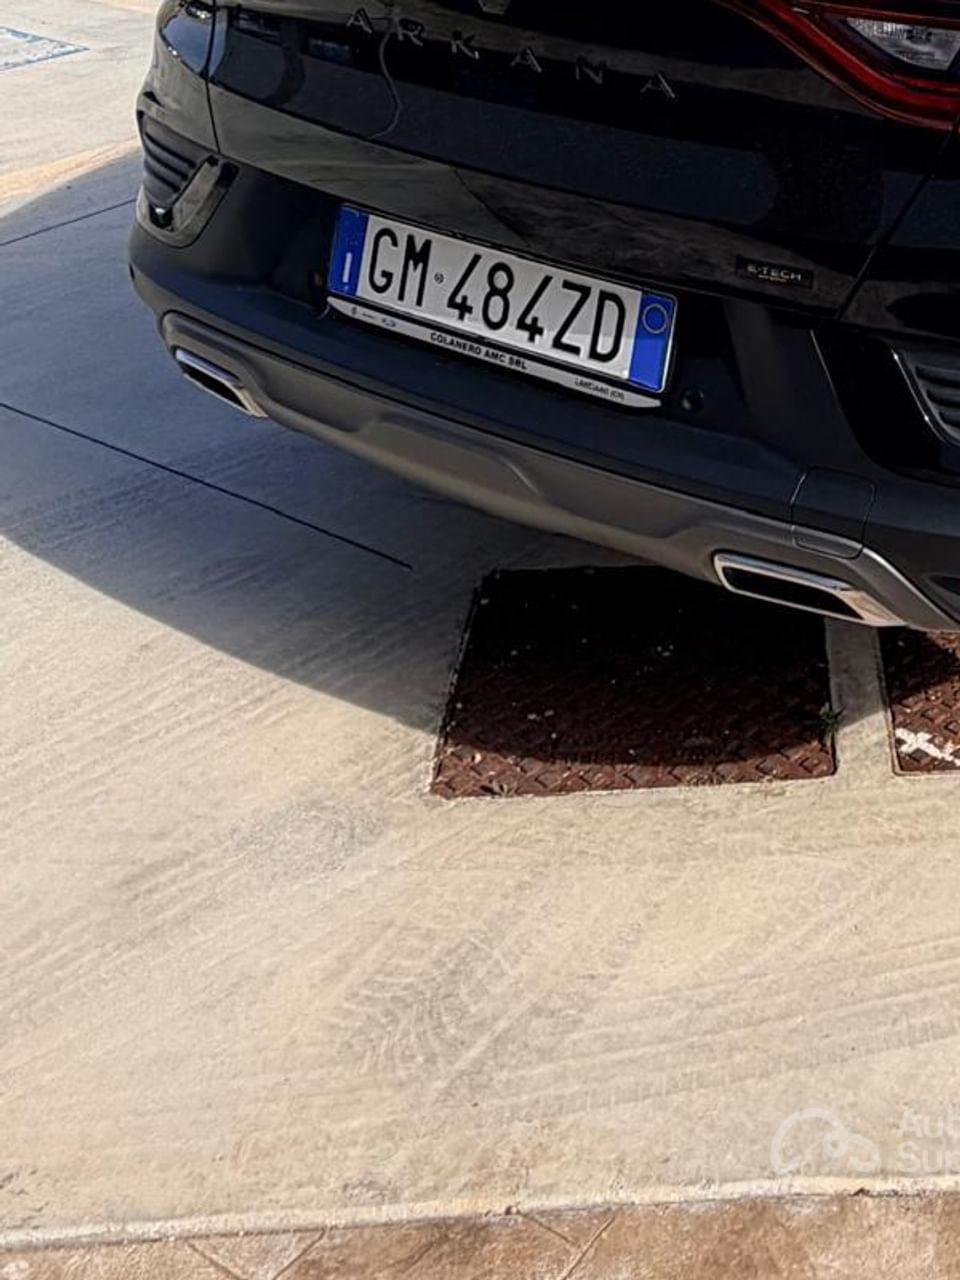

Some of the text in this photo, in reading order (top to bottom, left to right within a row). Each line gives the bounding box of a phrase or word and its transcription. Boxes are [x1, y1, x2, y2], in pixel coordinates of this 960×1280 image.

[346, 7, 677, 100] ARKANA
[430, 332, 528, 370] COLANERO AMC SRL
